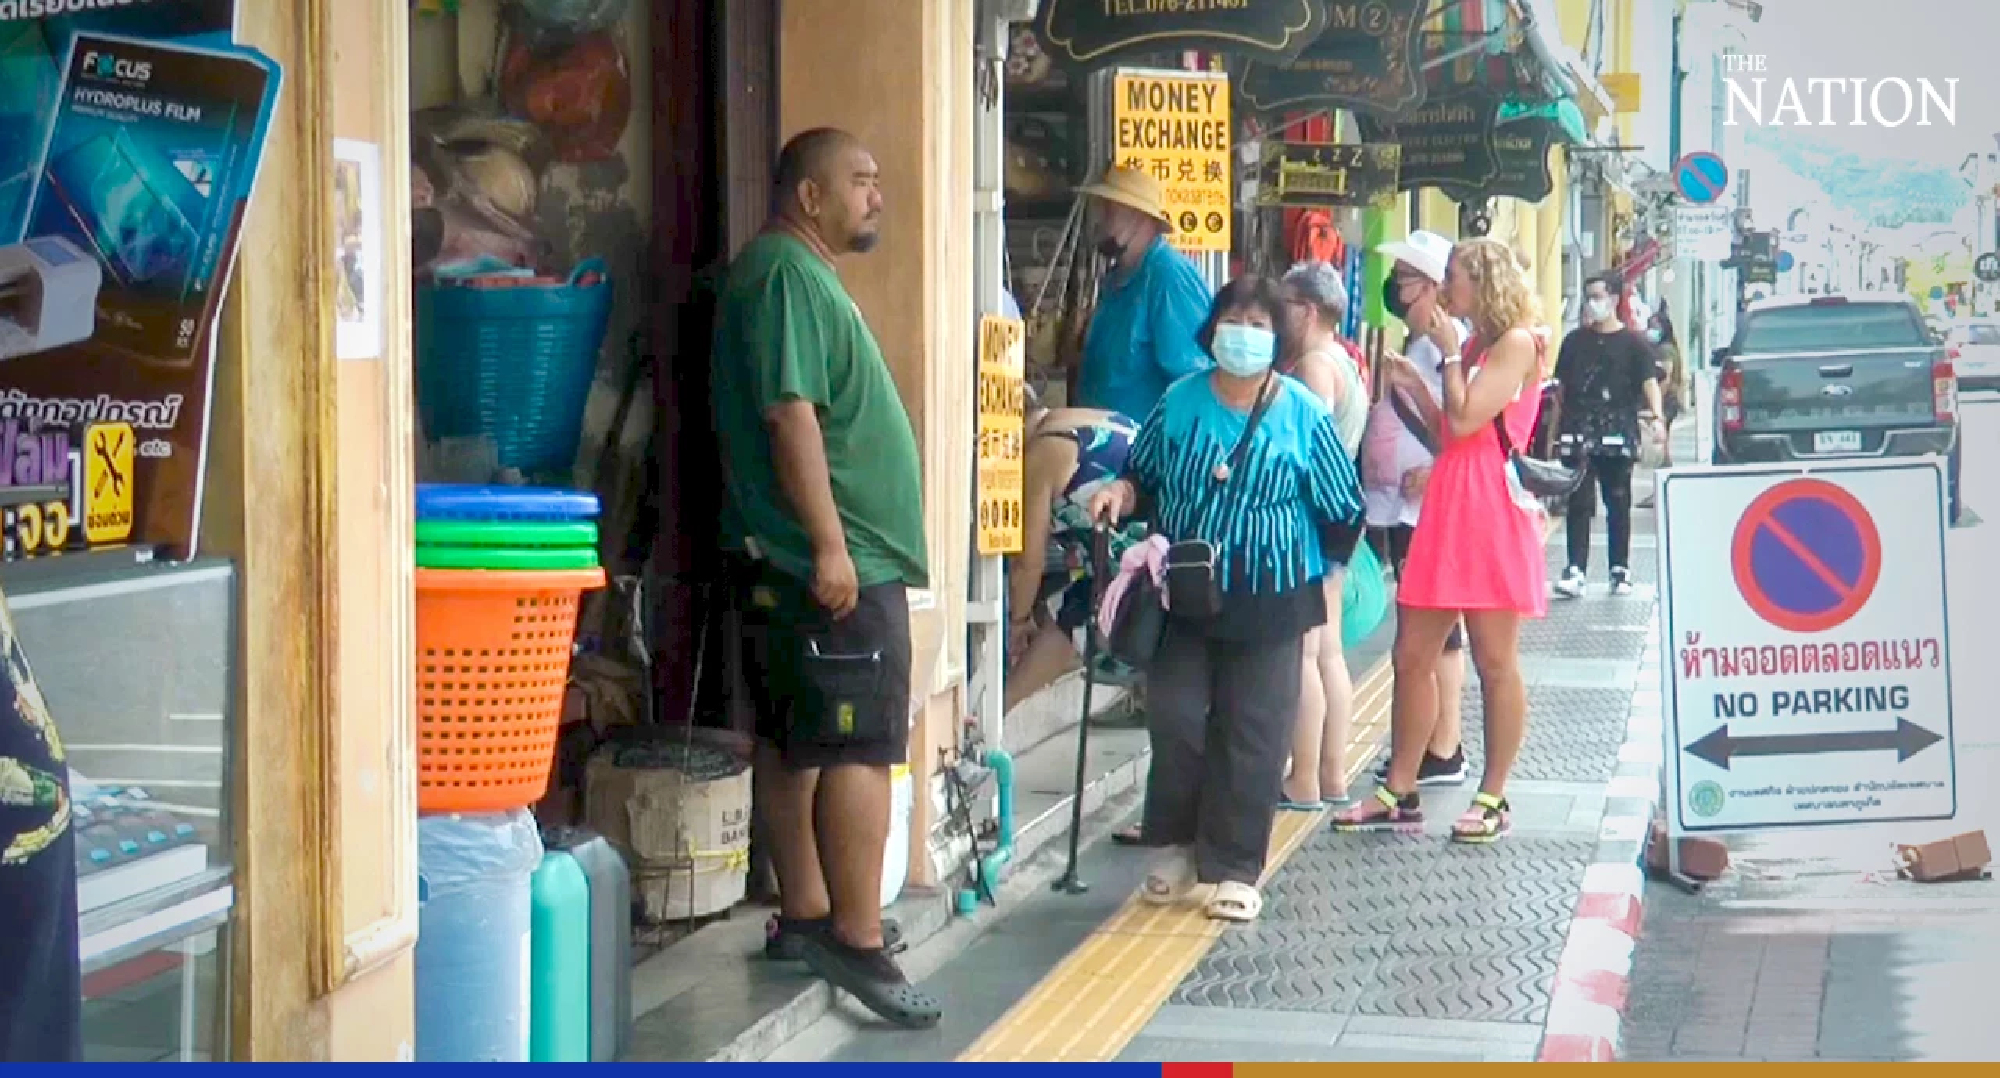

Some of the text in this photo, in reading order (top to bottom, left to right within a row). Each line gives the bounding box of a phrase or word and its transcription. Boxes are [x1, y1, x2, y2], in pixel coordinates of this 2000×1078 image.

[82, 51, 153, 81] FOCUS
[74, 86, 201, 122] HYDROPLUS FILM
[1127, 80, 1217, 114] MONEY
[1119, 117, 1227, 151] EXCHANGE
[982, 319, 1021, 364] MONEY
[980, 371, 1023, 417] EXCHANGE
[1680, 631, 1941, 679] ห้ามจอดตลอดแนว
[1713, 684, 1910, 719] NO PARKING
